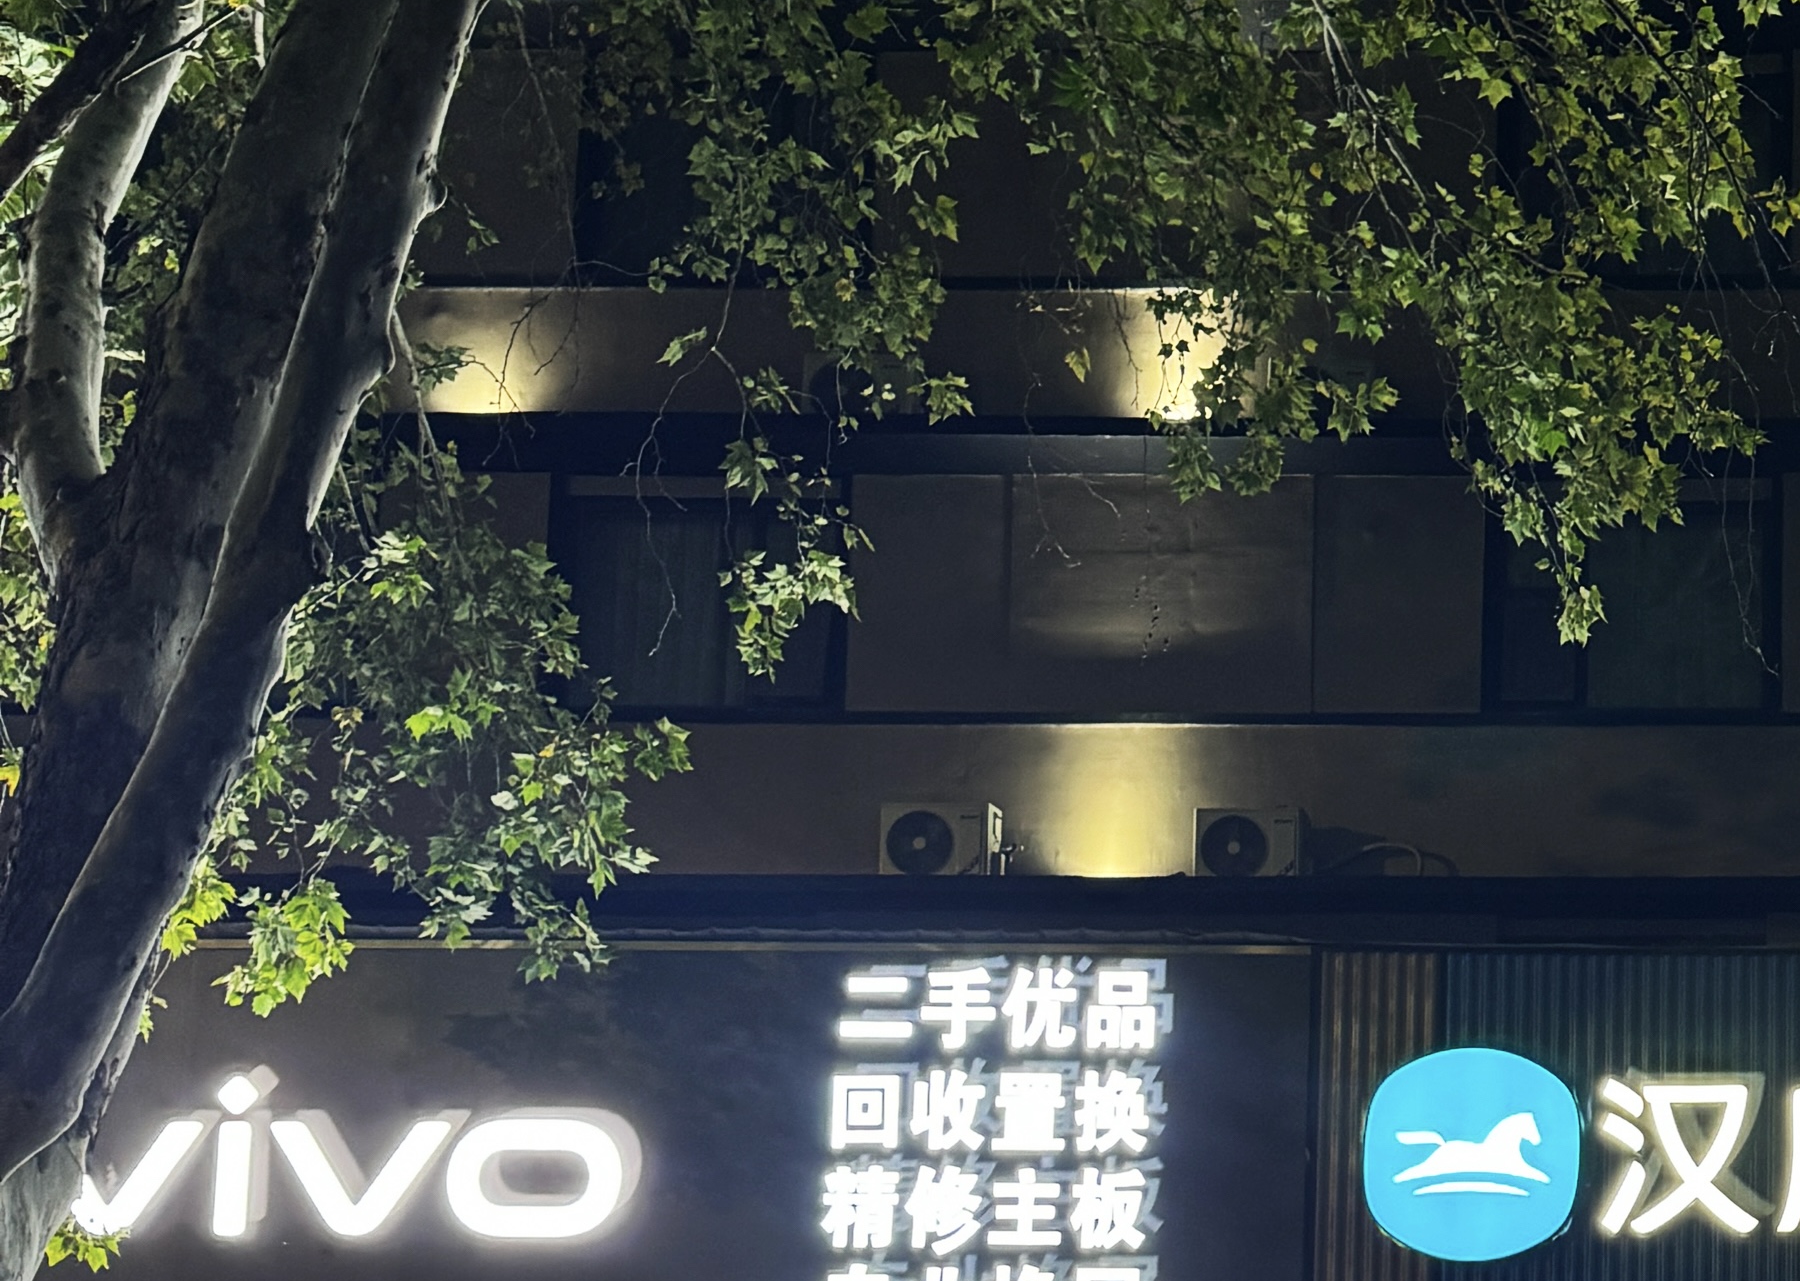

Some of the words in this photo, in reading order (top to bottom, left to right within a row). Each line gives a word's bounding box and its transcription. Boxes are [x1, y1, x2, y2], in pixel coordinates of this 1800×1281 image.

[838, 969, 1158, 1051] 二手优品
[831, 1071, 1149, 1154] 回收置换
[75, 1071, 624, 1240] vivo
[822, 1170, 1146, 1253] 精修主板
